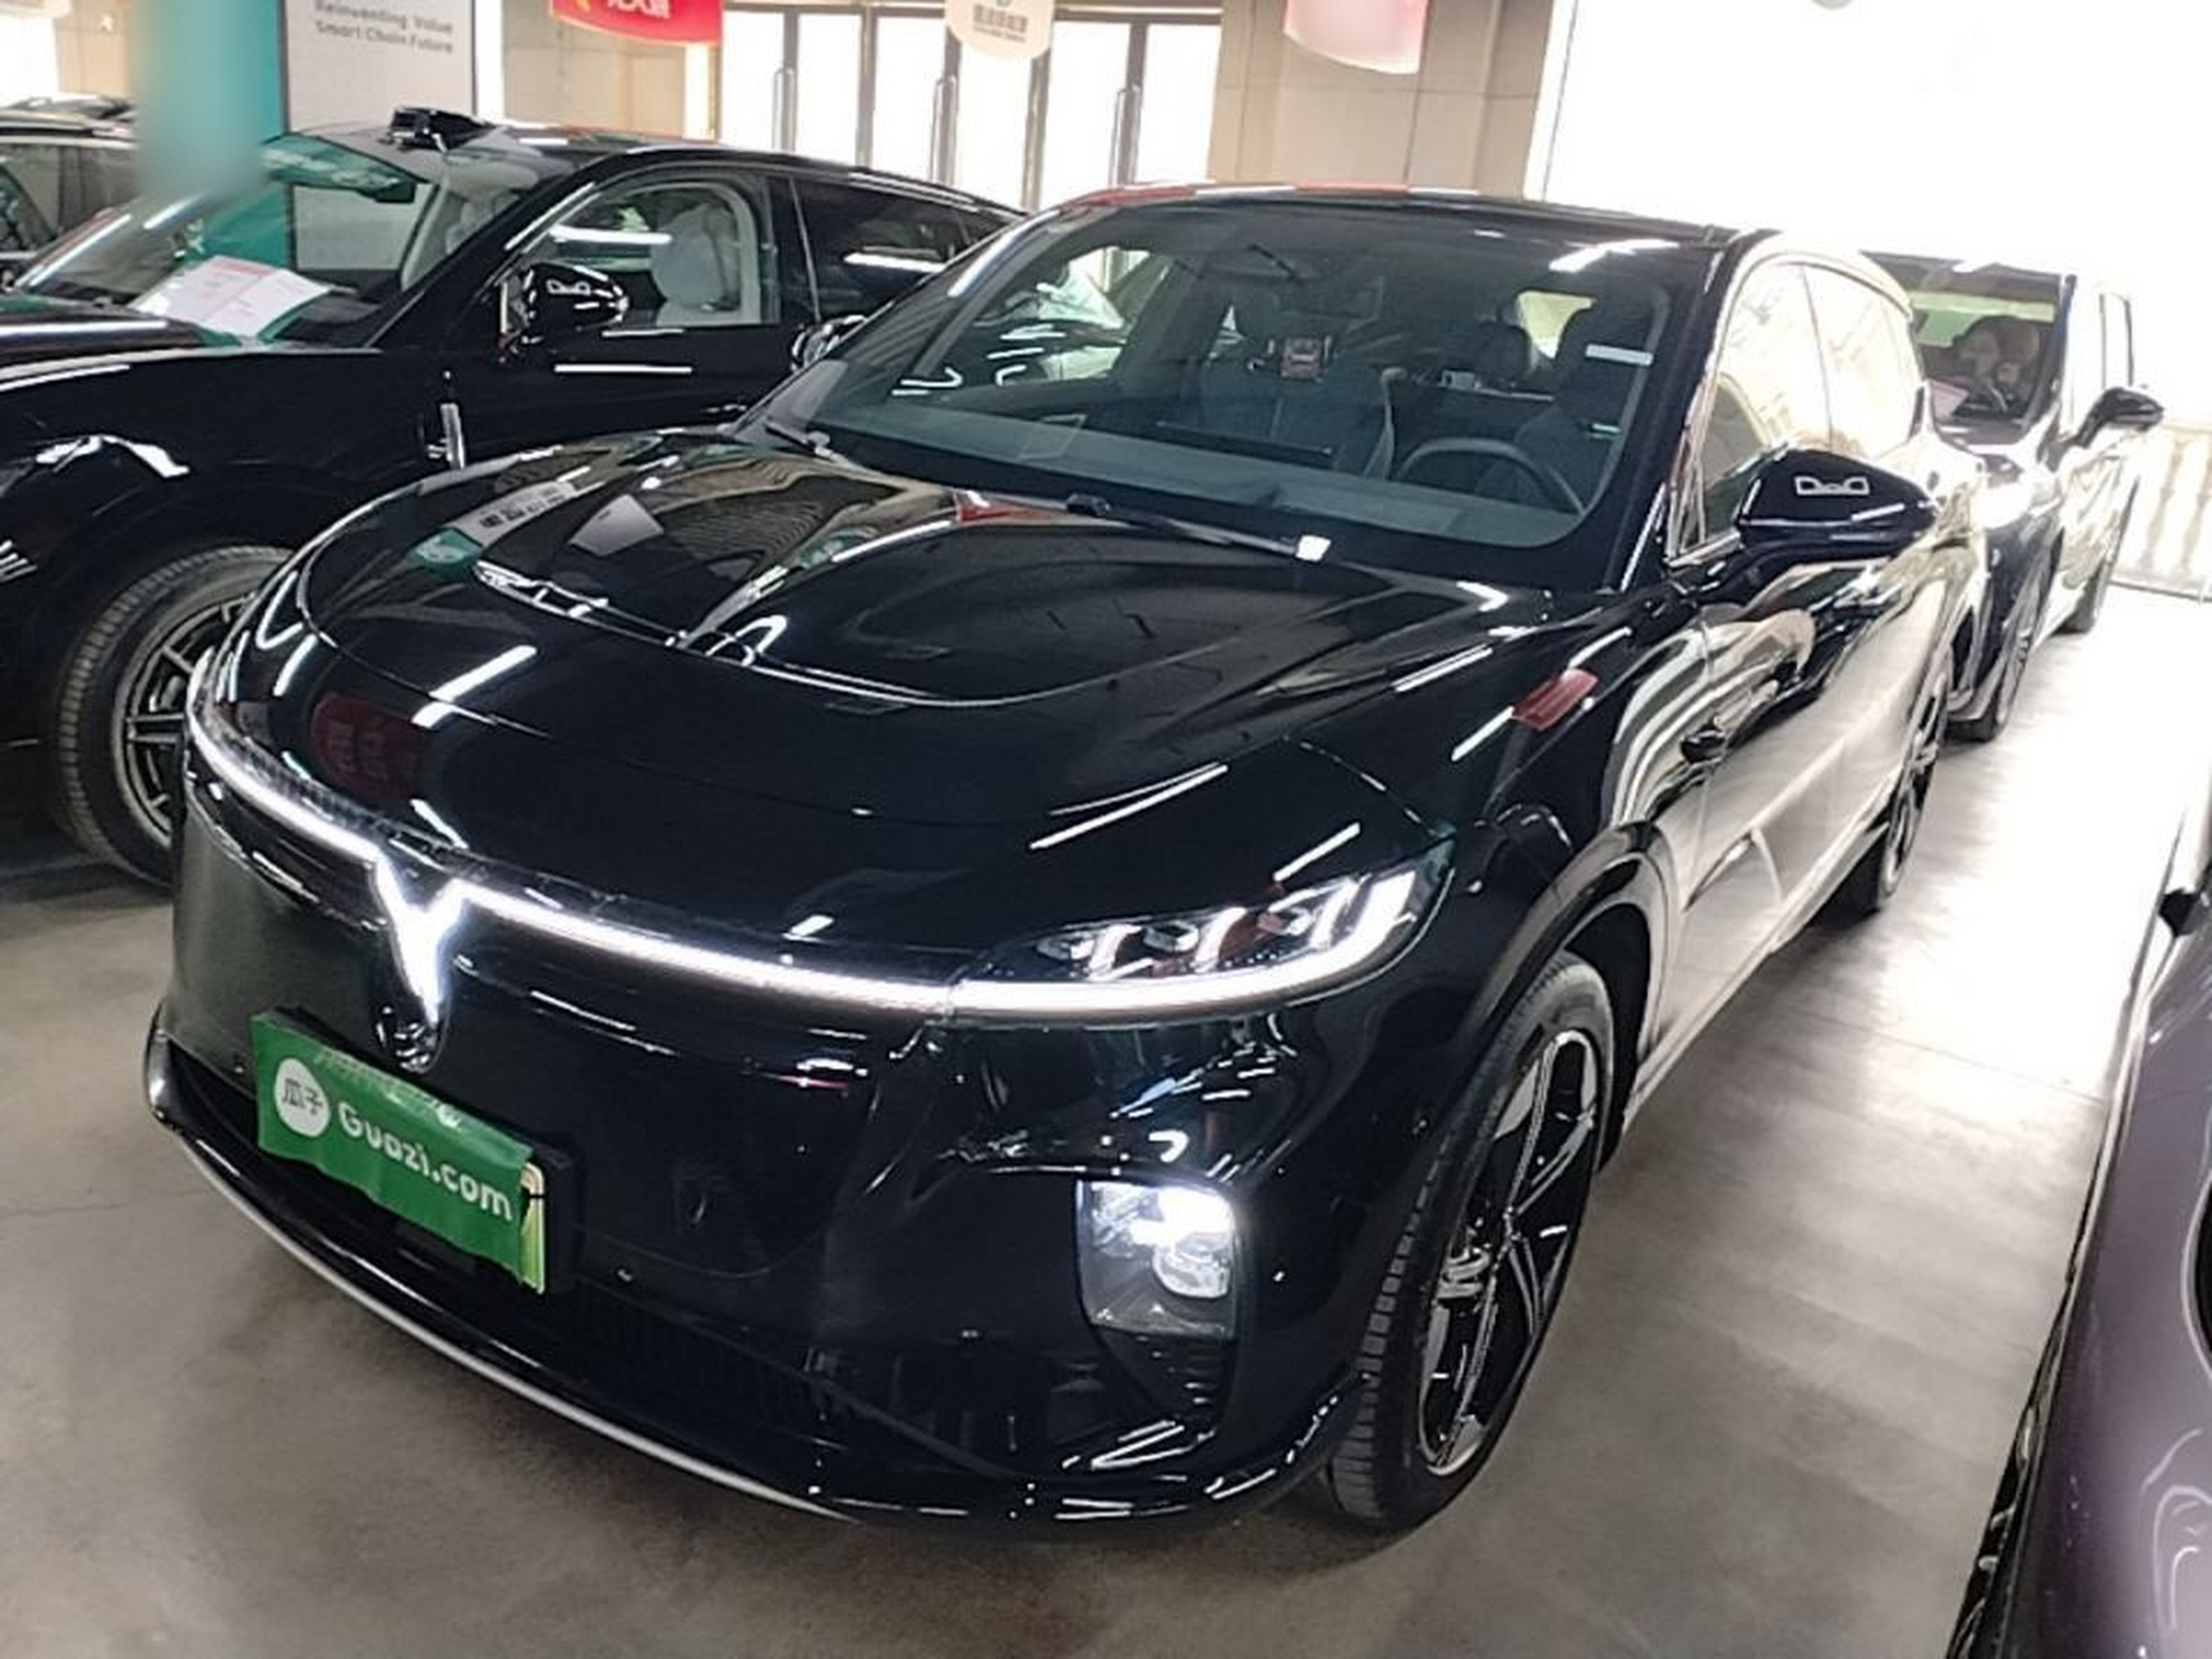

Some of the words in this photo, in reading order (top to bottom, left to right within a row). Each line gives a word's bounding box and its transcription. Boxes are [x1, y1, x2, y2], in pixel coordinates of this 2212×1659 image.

[315, 20, 361, 38] Smart
[365, 27, 407, 44] Chain
[411, 34, 453, 54] Future
[414, 16, 453, 33] Value
[282, 1077, 323, 1116] 瓜子
[338, 1101, 513, 1221] Guazi.com
